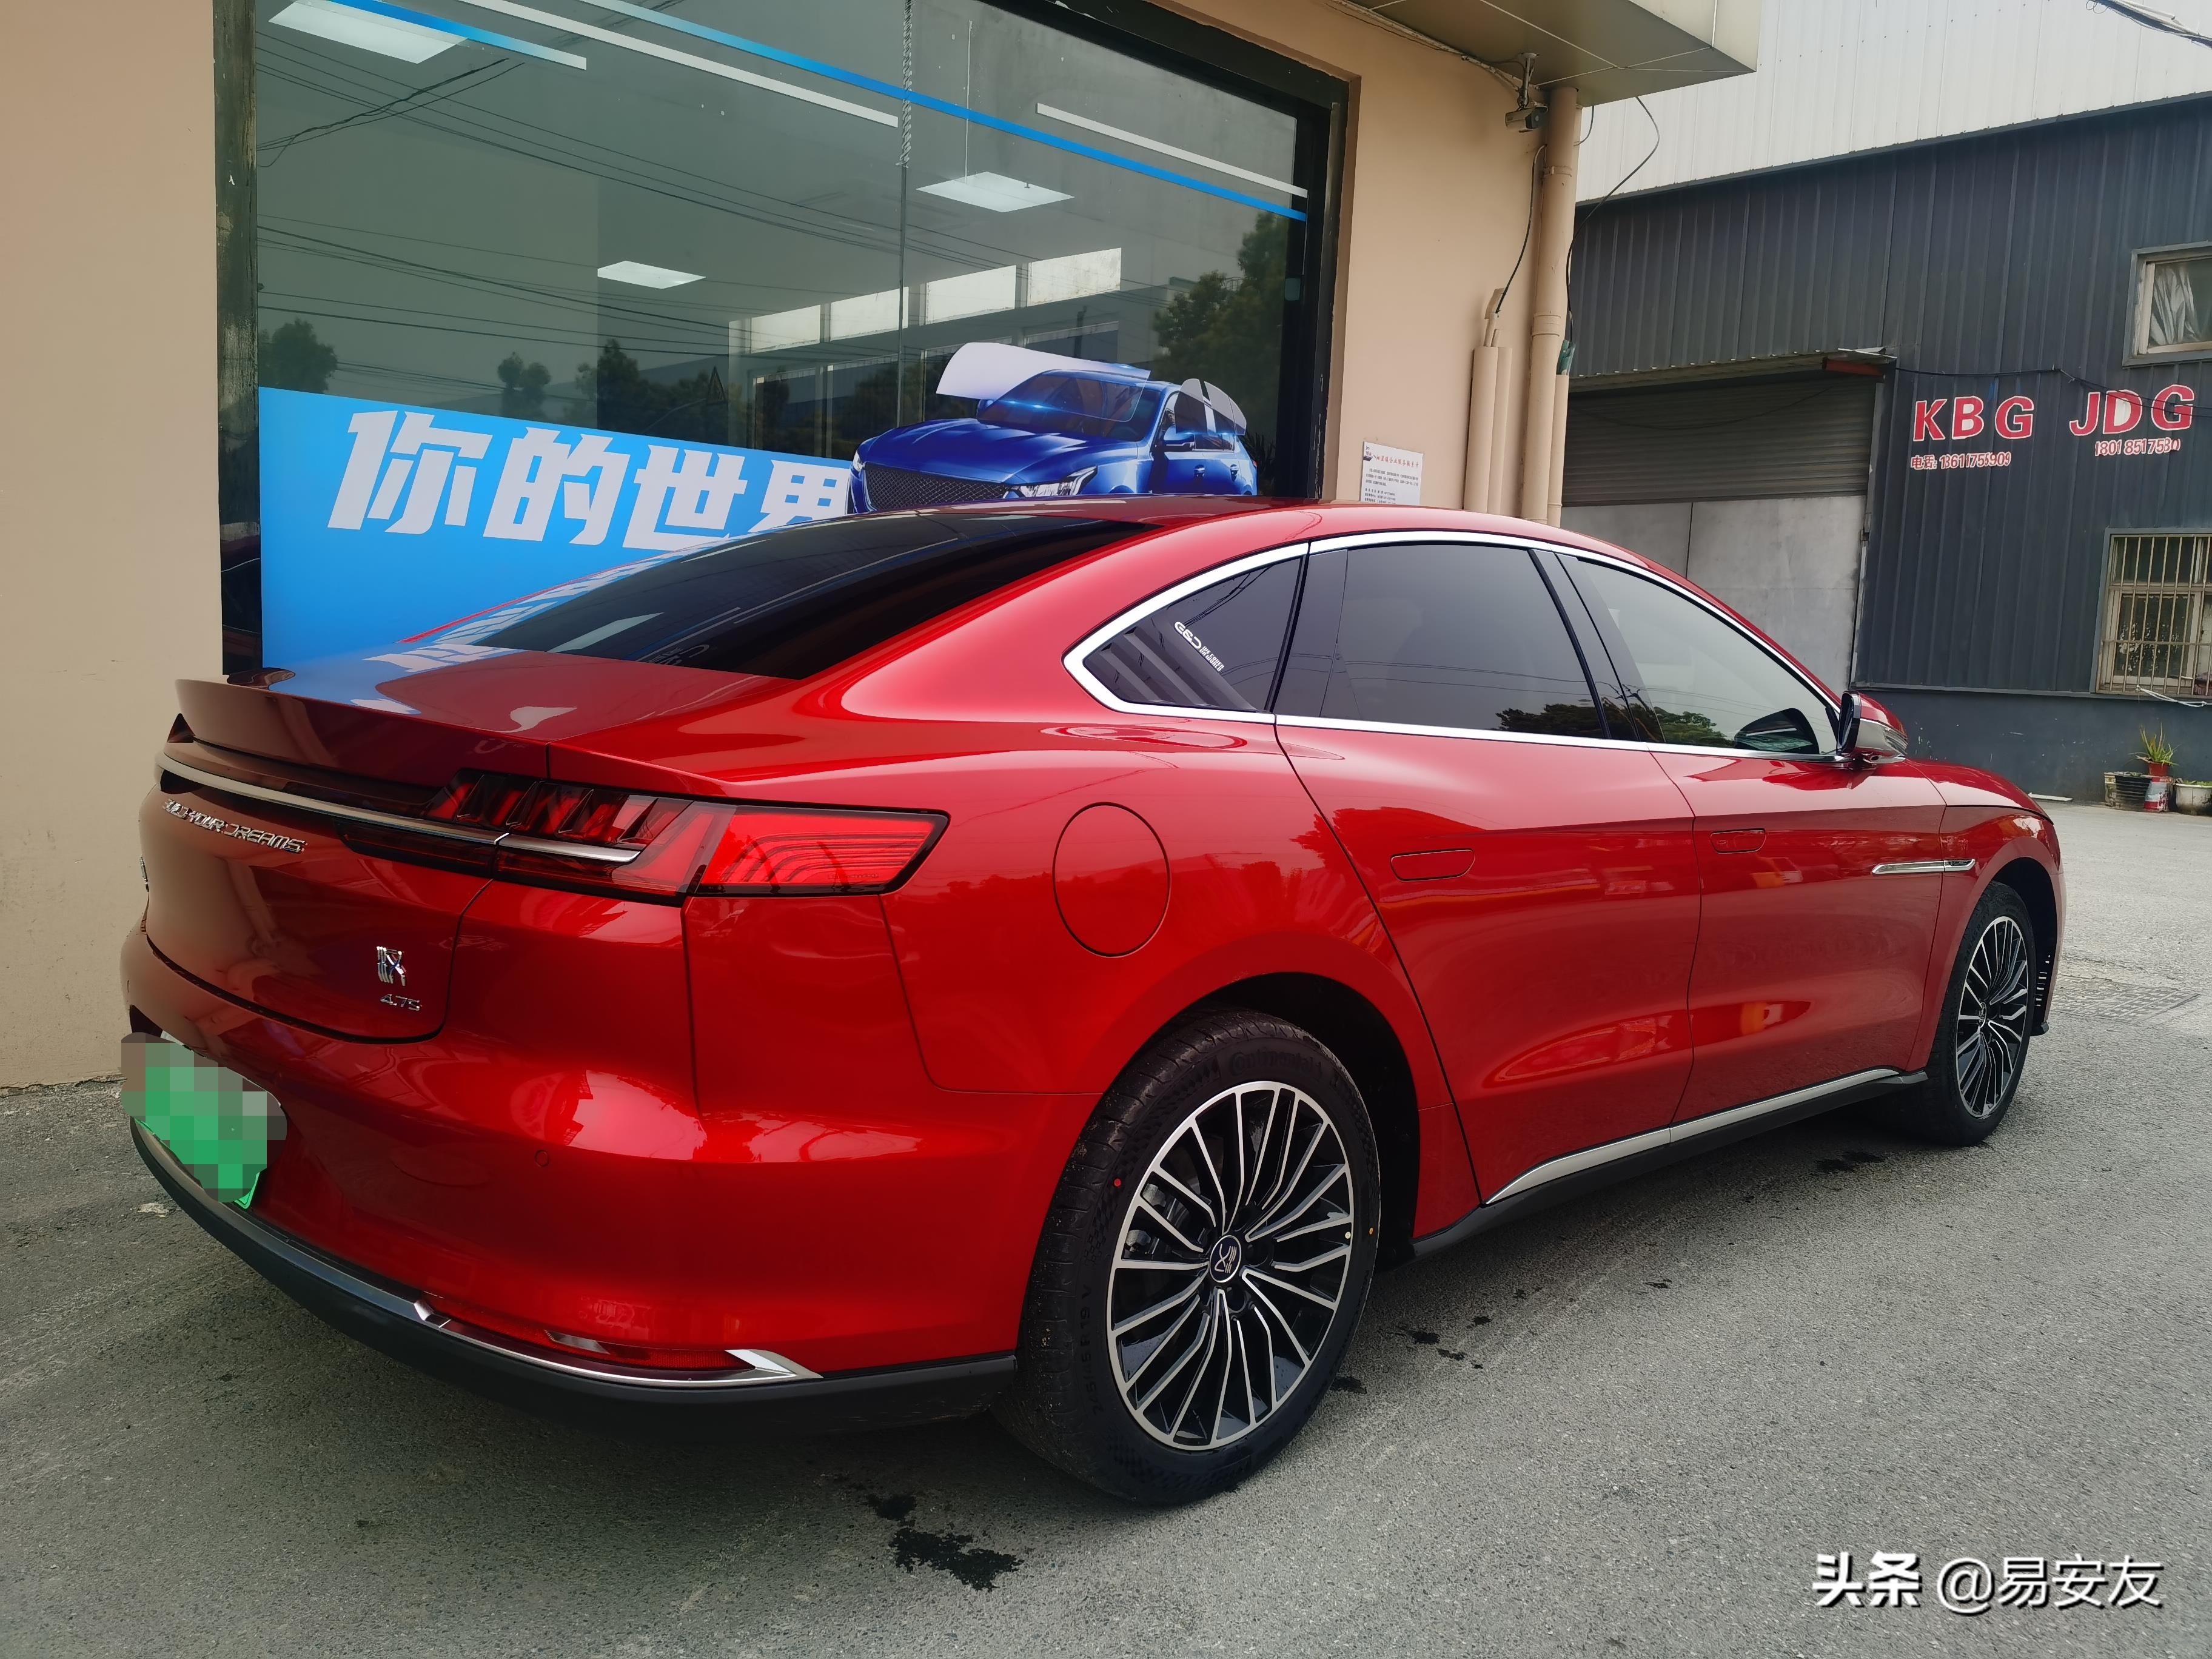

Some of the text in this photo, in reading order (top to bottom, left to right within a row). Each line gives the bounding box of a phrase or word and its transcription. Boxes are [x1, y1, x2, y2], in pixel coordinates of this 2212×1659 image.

[1913, 384, 2194, 441] KBG JDG
[328, 409, 850, 551] 你的世界
[223, 823, 308, 853] DREAMS
